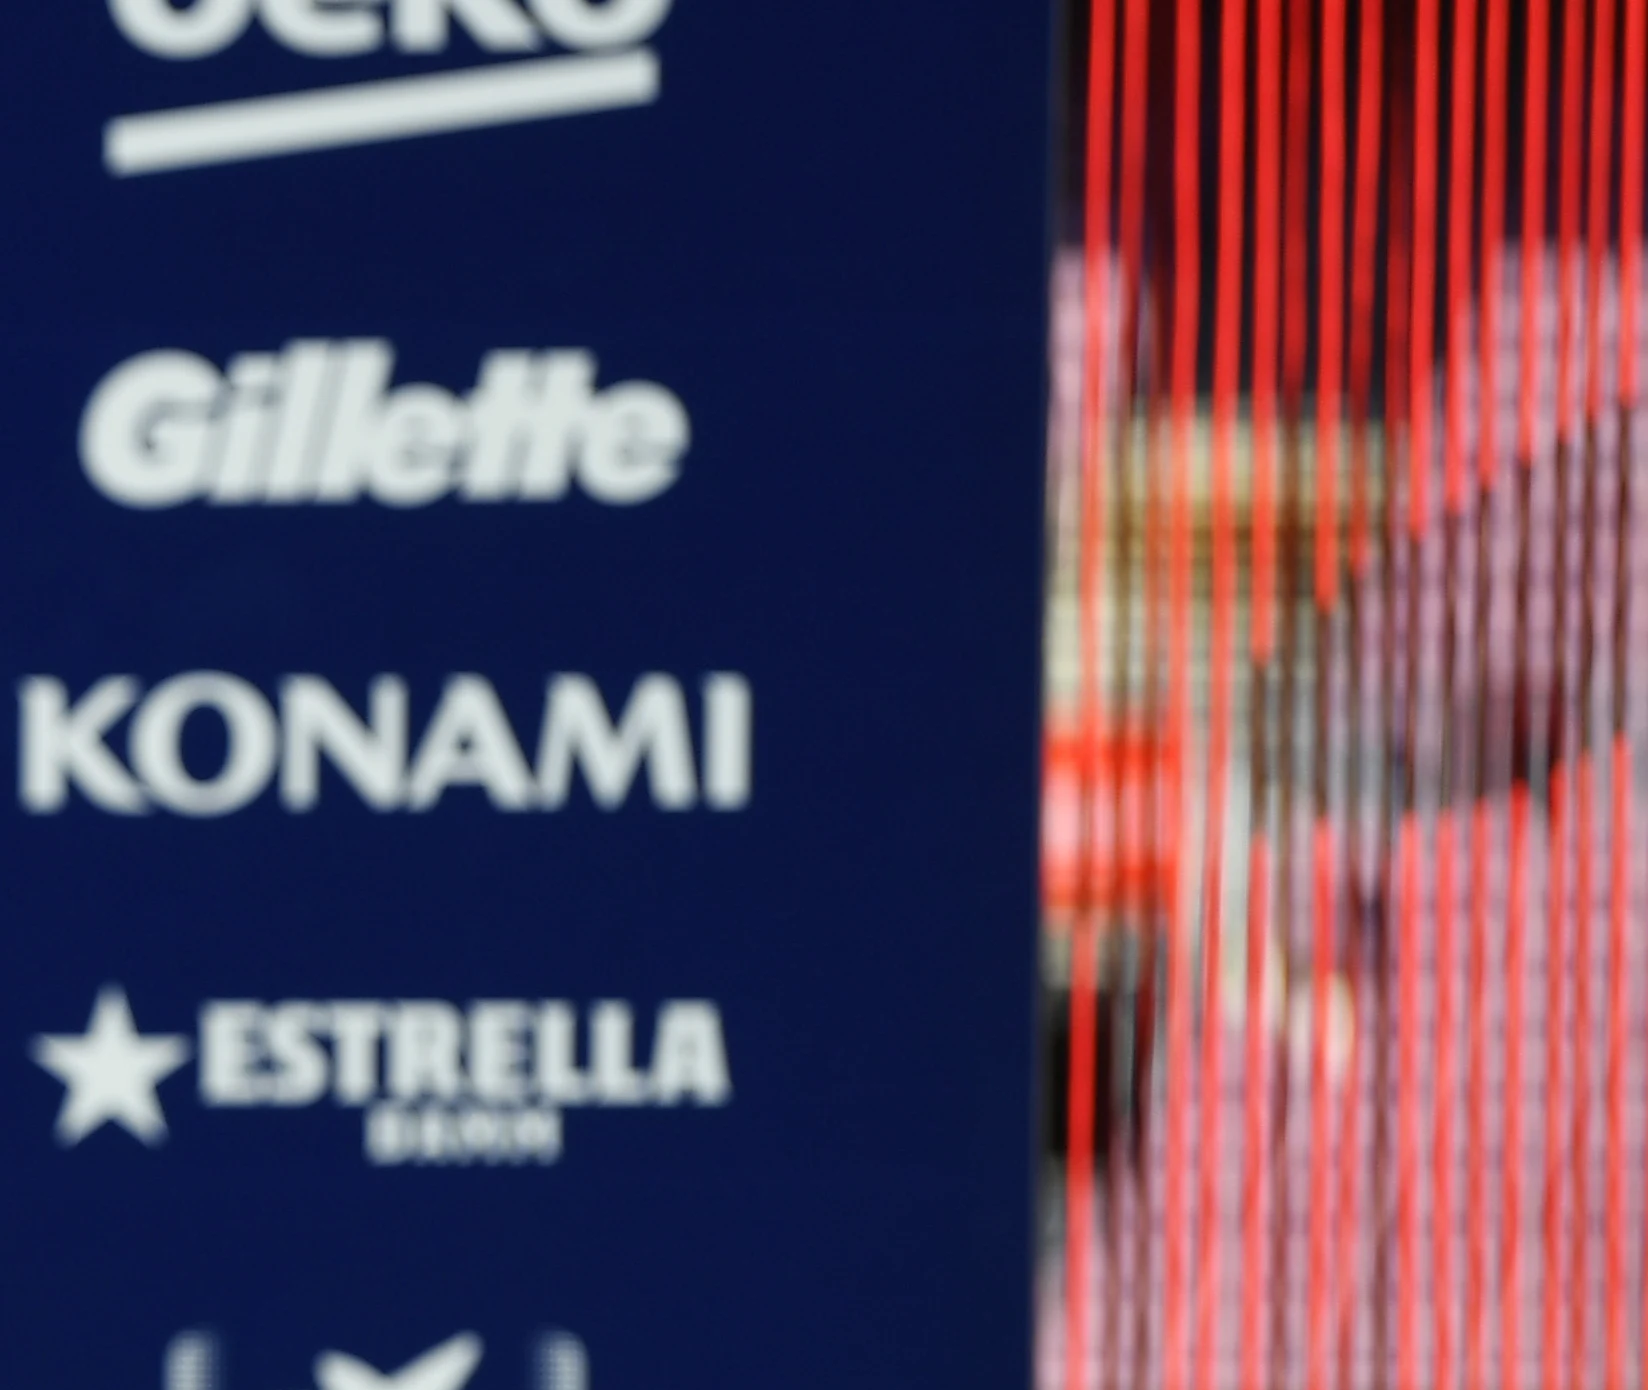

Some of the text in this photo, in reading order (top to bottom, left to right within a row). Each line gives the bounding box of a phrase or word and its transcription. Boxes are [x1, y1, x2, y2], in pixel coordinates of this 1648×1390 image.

[81, 341, 688, 504] Gillette
[20, 673, 750, 813] KONAMI
[200, 1000, 730, 1104] ESTRELLA
